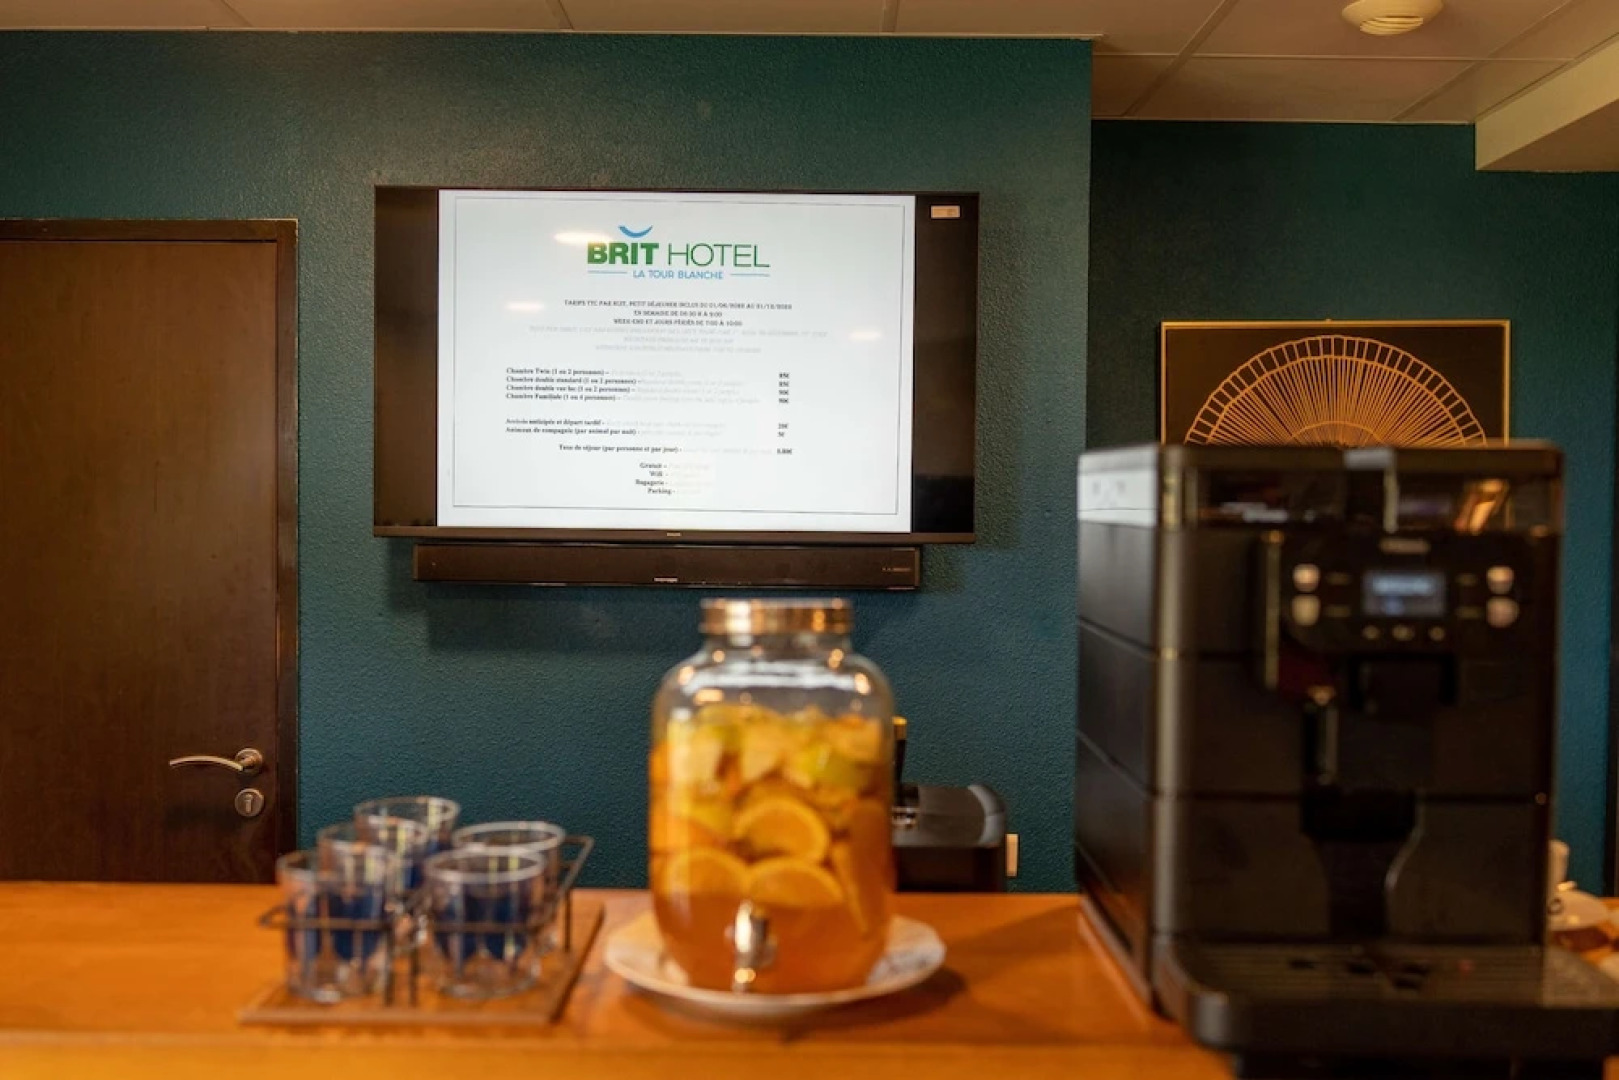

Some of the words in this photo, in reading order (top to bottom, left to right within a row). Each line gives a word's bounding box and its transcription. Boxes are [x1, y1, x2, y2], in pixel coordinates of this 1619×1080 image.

[587, 243, 659, 265] BRIT
[668, 243, 770, 268] HOTEL
[632, 270, 645, 279] LA
[650, 270, 674, 279] TOUR
[677, 270, 723, 280] BLANCHE
